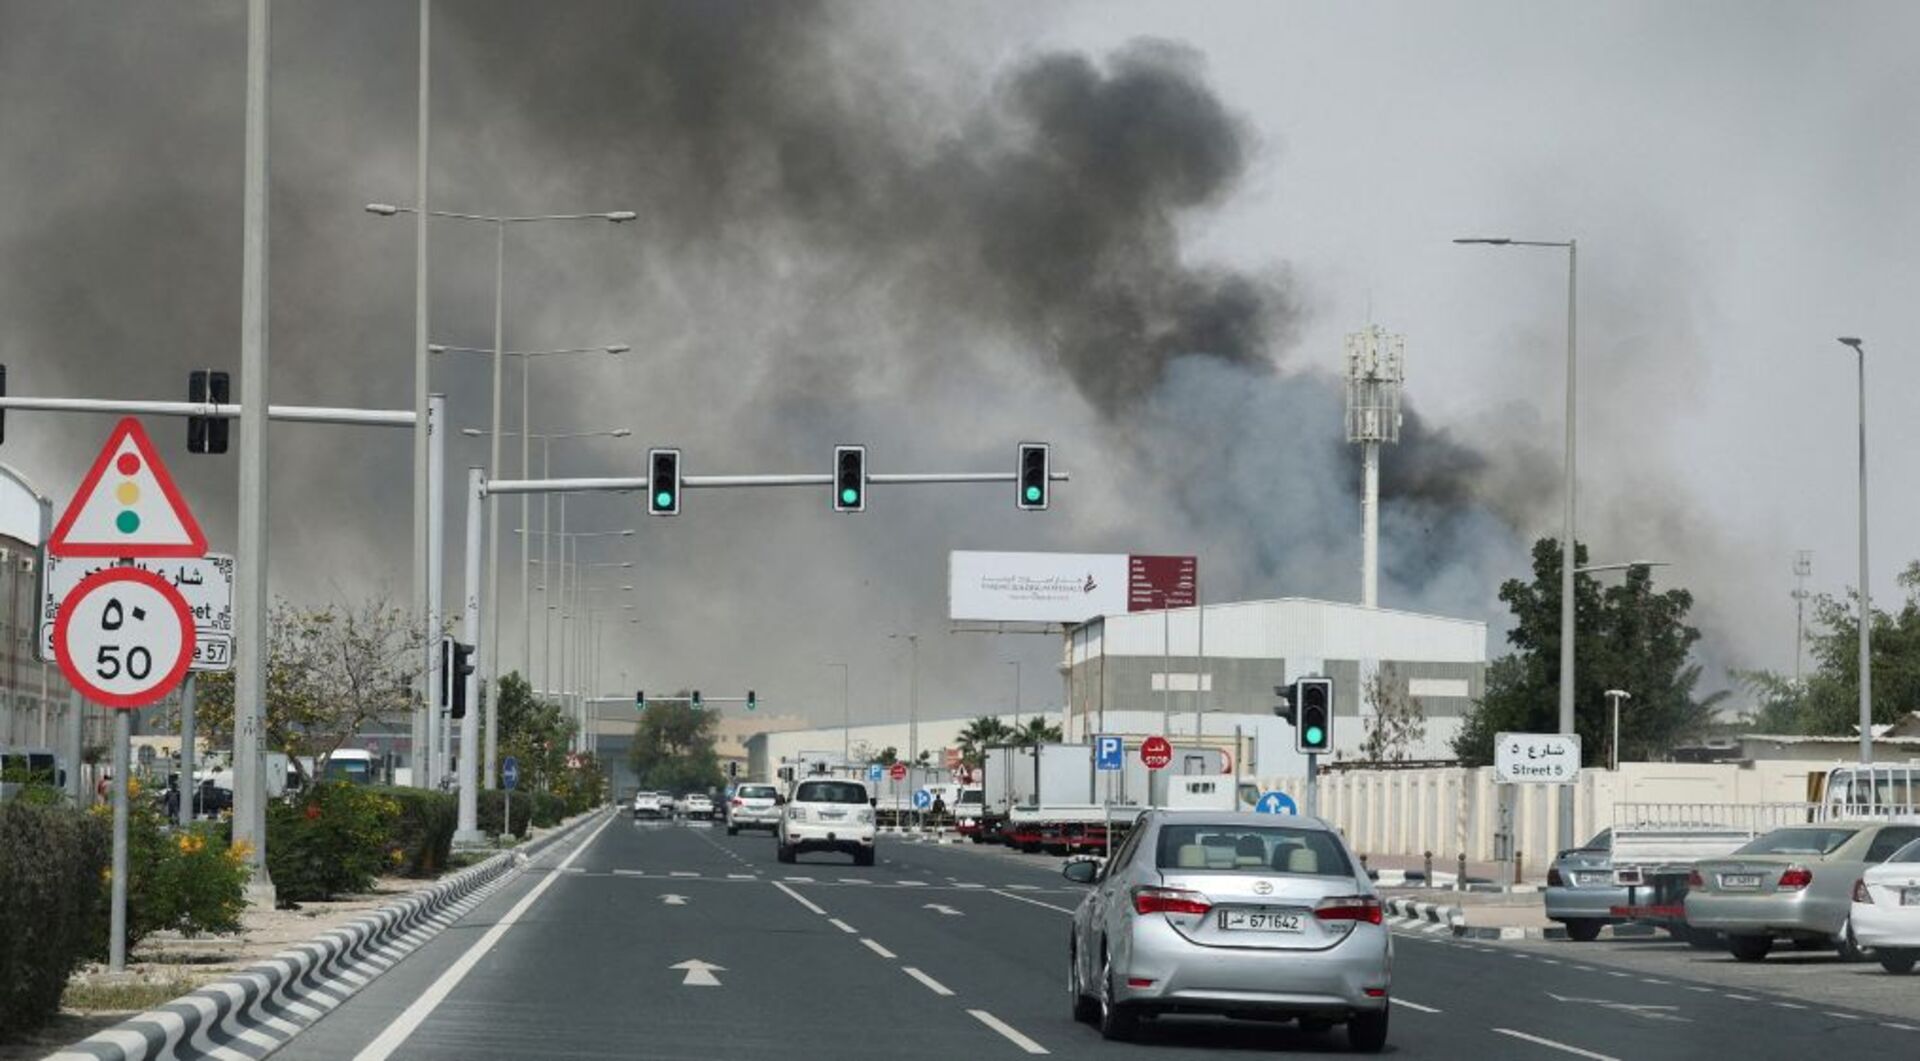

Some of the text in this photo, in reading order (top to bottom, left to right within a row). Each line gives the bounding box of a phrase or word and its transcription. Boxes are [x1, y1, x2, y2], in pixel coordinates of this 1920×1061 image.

[101, 597, 146, 631] ٥٠
[207, 644, 226, 660] 57
[97, 645, 152, 681] 50
[1102, 739, 1117, 759] P
[1512, 744, 1565, 759] شارع ٥
[1145, 756, 1169, 764] STOP
[1512, 763, 1563, 776] Street 5
[1250, 914, 1299, 930] 671642
